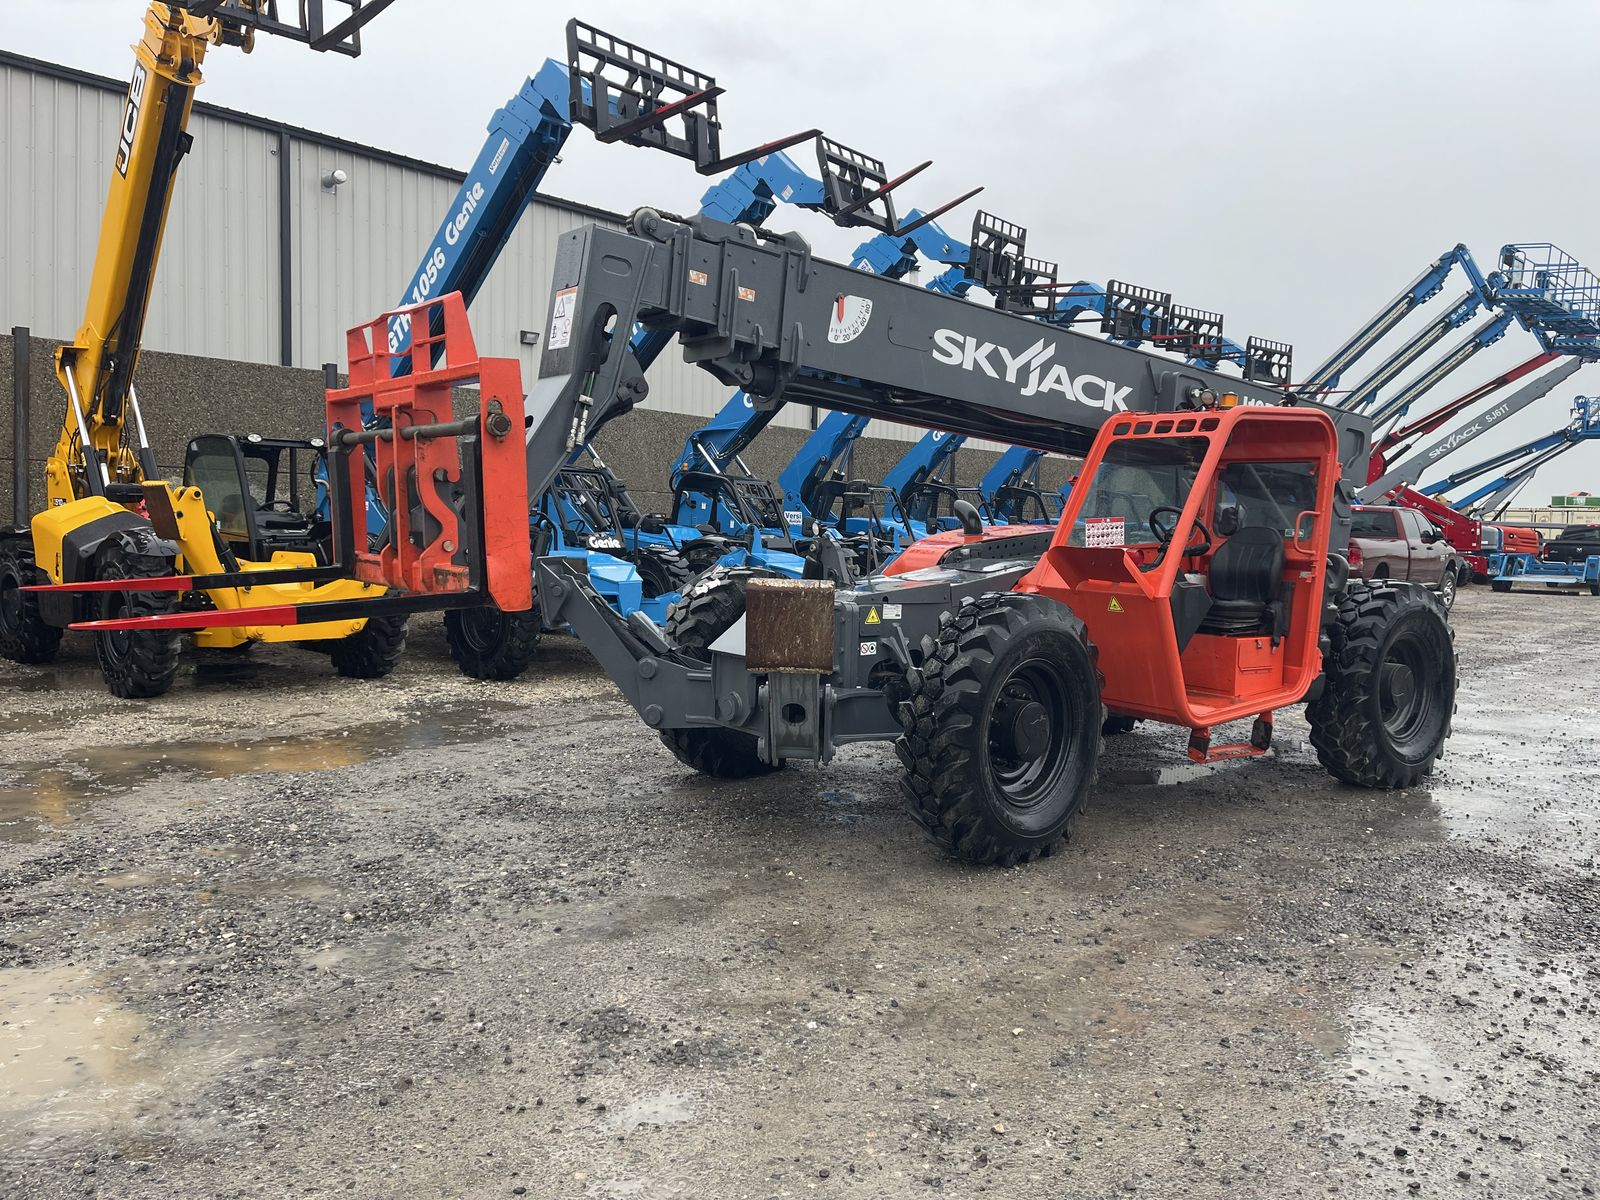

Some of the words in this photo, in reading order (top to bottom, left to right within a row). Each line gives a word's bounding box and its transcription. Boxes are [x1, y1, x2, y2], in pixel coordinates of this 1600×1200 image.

[119, 65, 146, 175] JCB
[445, 182, 485, 245] Genie
[932, 328, 1133, 412] SKYJACK
[1428, 423, 1483, 459] SKYJACK
[1485, 403, 1510, 423] SJ61T
[589, 536, 621, 548] Genie
